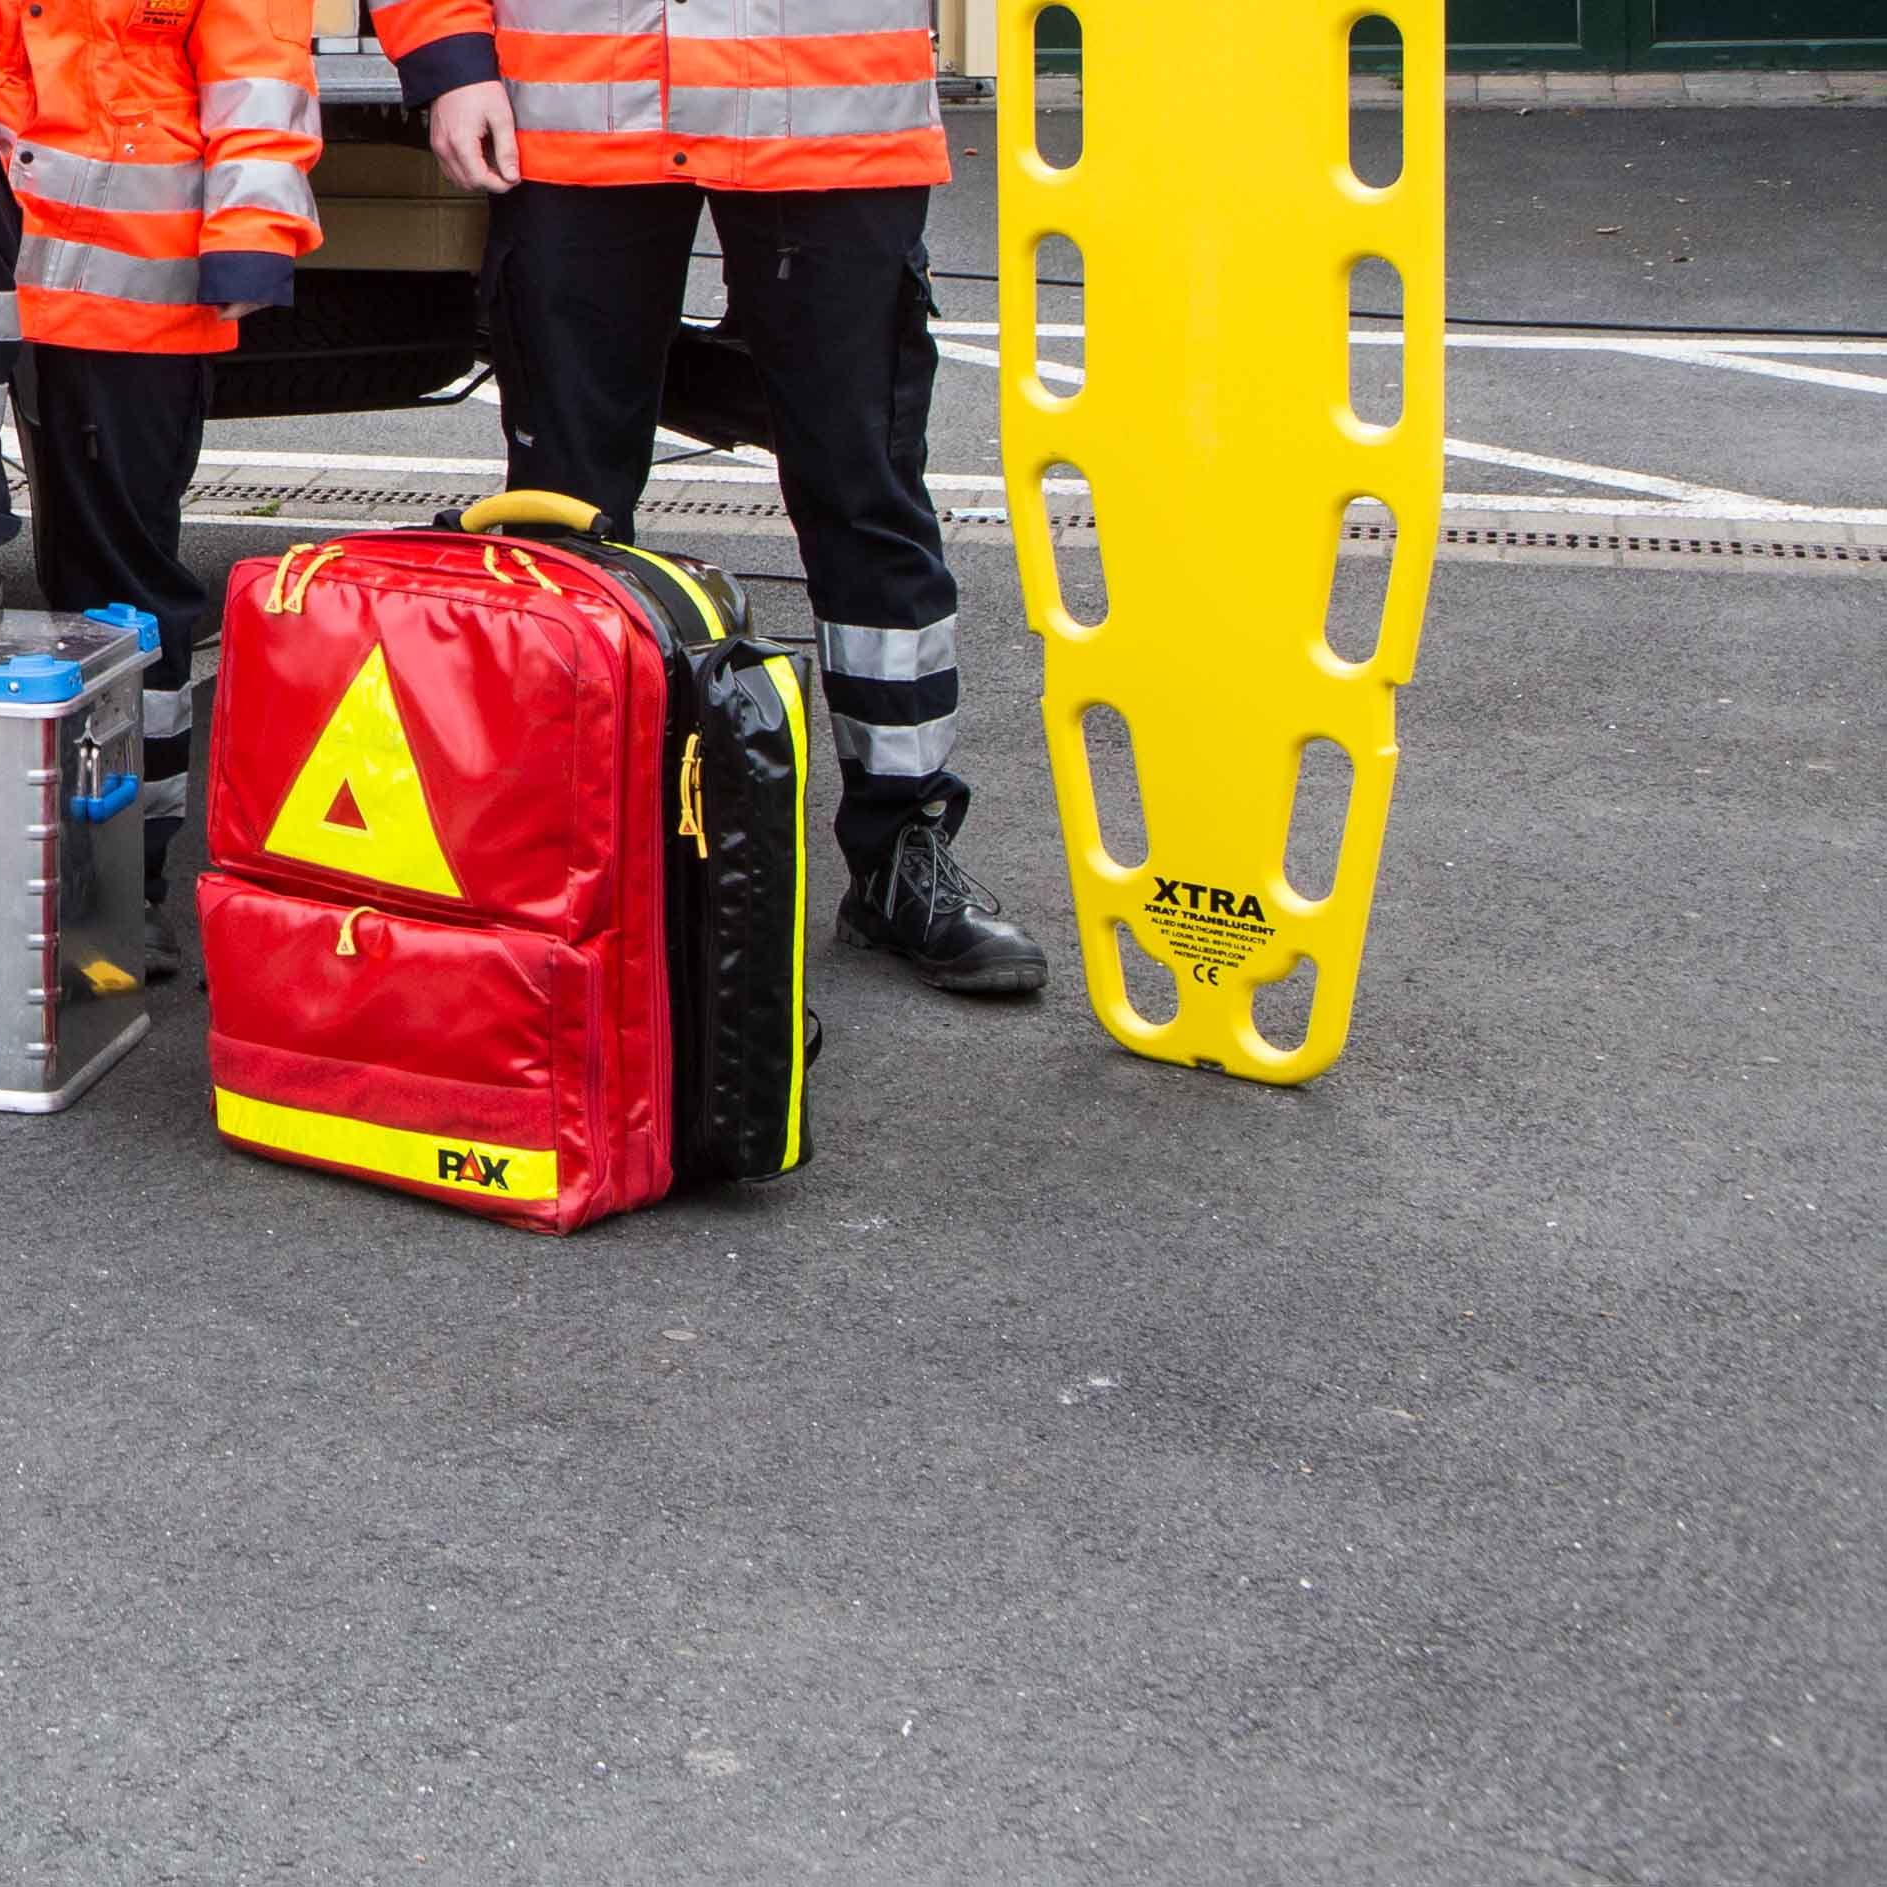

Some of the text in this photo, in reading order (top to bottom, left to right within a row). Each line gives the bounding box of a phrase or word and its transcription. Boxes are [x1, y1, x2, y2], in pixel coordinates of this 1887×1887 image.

[1153, 876, 1266, 923] XTRA
[1144, 903, 1277, 937] XRAY TRANSLUCENT
[1151, 916, 1176, 927] ALLIED
[1225, 931, 1267, 946] PRODUCTS
[1173, 950, 1201, 961] PATENT
